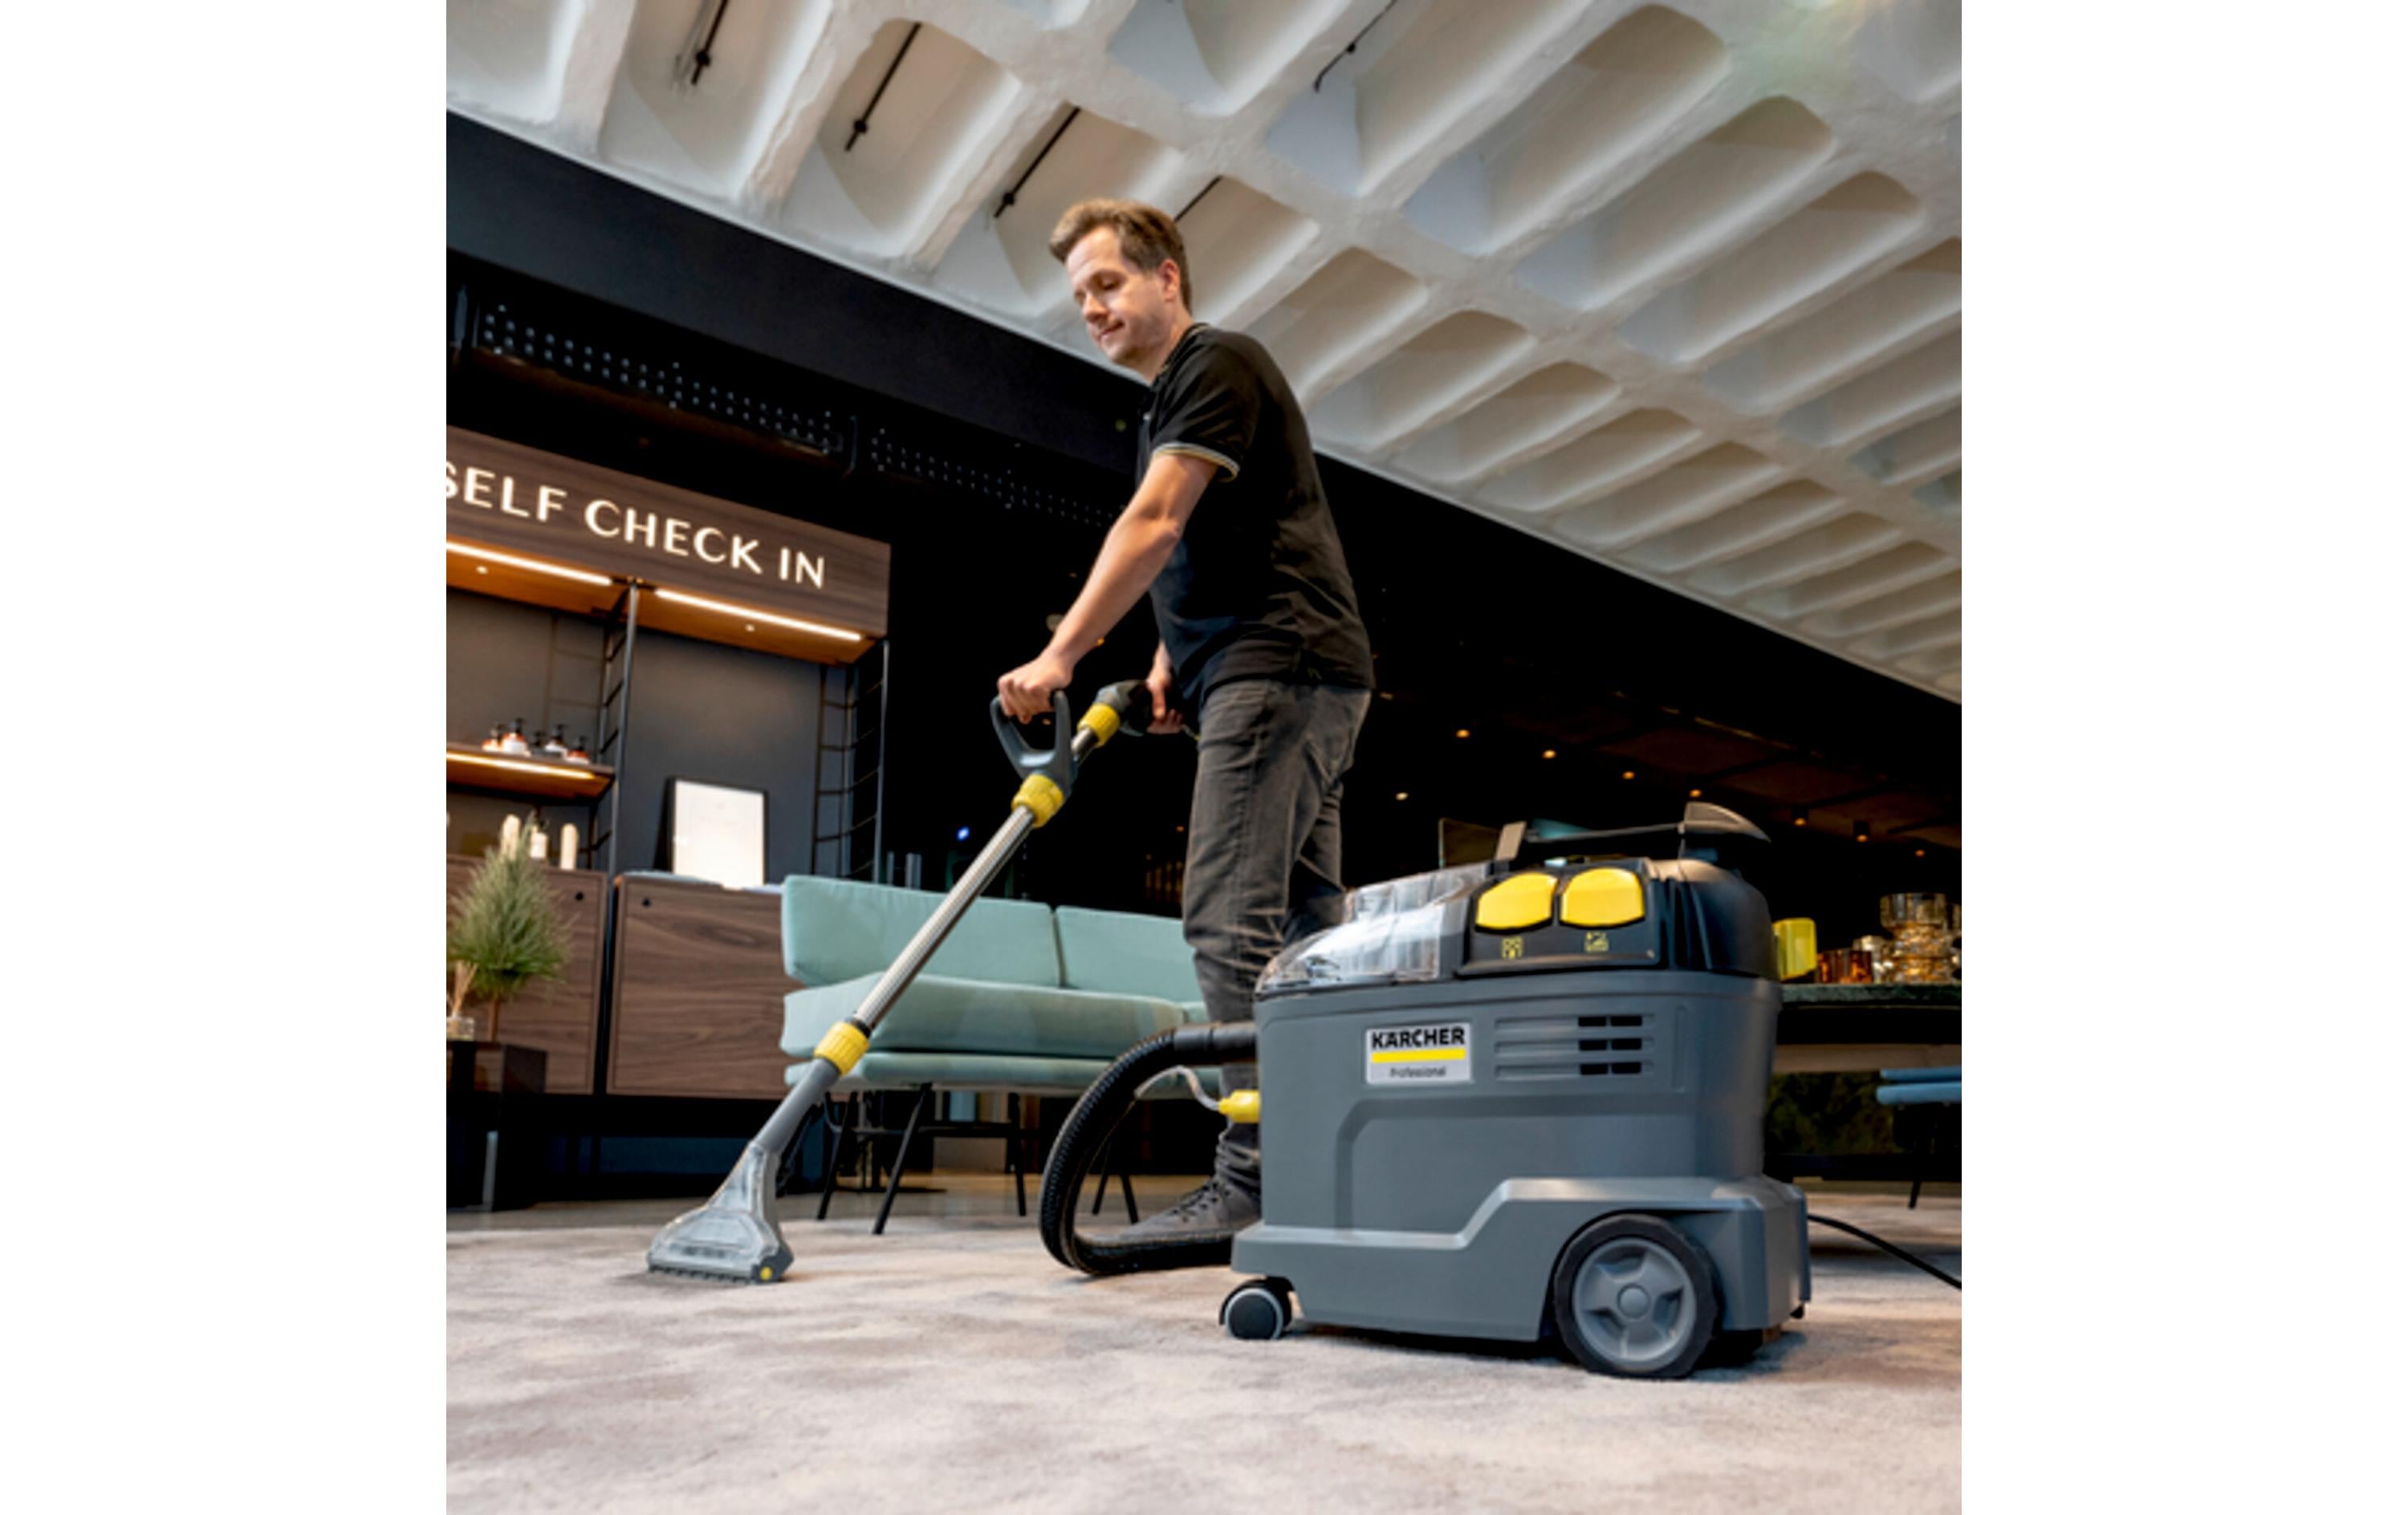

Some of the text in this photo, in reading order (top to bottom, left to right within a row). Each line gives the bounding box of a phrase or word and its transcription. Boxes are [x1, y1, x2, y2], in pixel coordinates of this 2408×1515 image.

[584, 499, 763, 575] CHECK
[779, 547, 826, 589] IN
[1372, 1026, 1465, 1049] KÄRCHER
[1389, 1066, 1446, 1078] Professional
